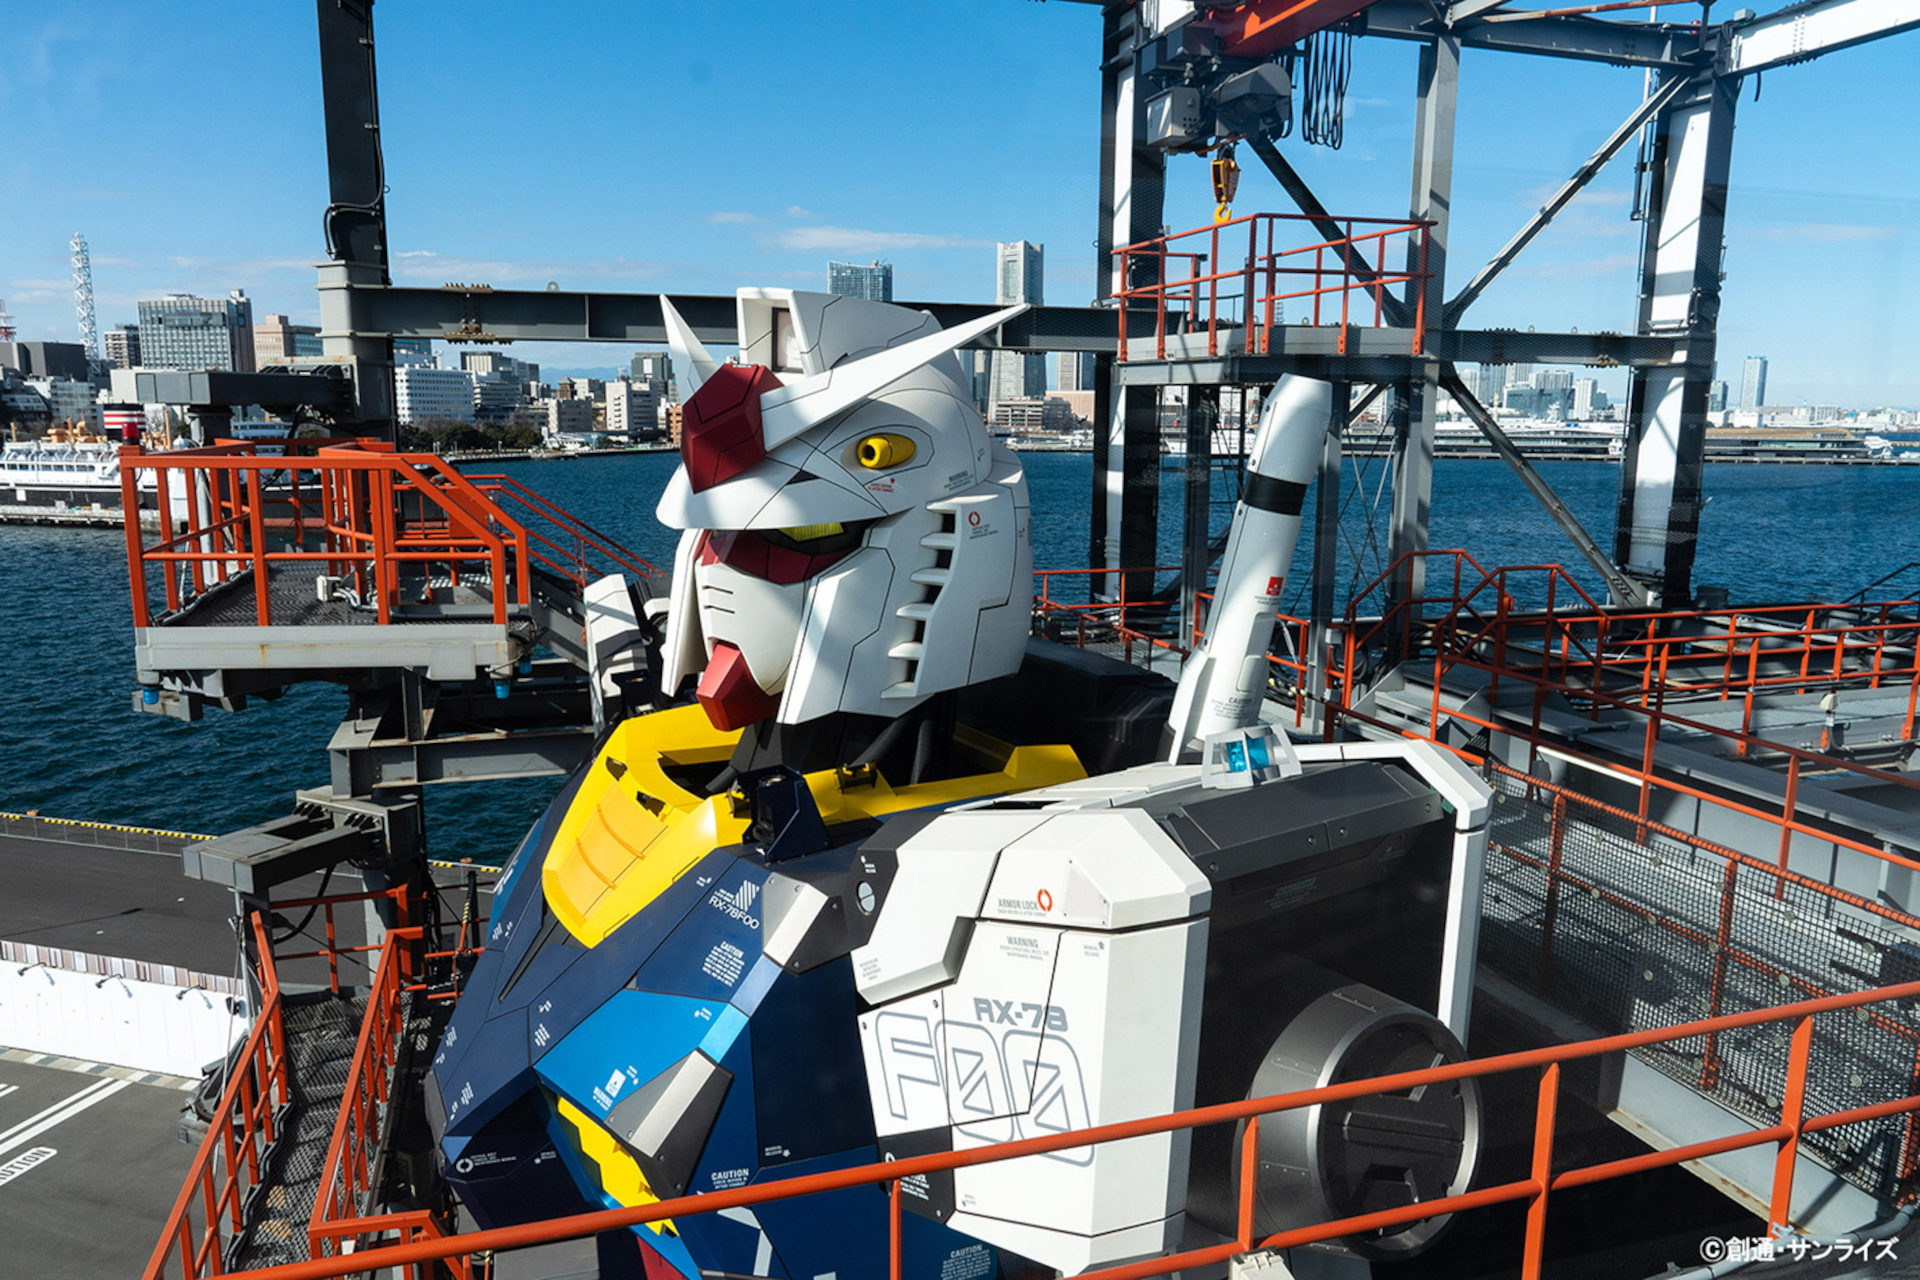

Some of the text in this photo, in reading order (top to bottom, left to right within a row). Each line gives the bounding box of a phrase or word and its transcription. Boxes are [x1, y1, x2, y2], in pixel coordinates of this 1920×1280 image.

[998, 898, 1039, 910] ARMOR LOCK
[1006, 936, 1039, 948] WARNING
[973, 997, 1068, 1032] RX-78
[711, 1168, 749, 1181] CAUTION
[950, 1244, 983, 1258] CAUTION
